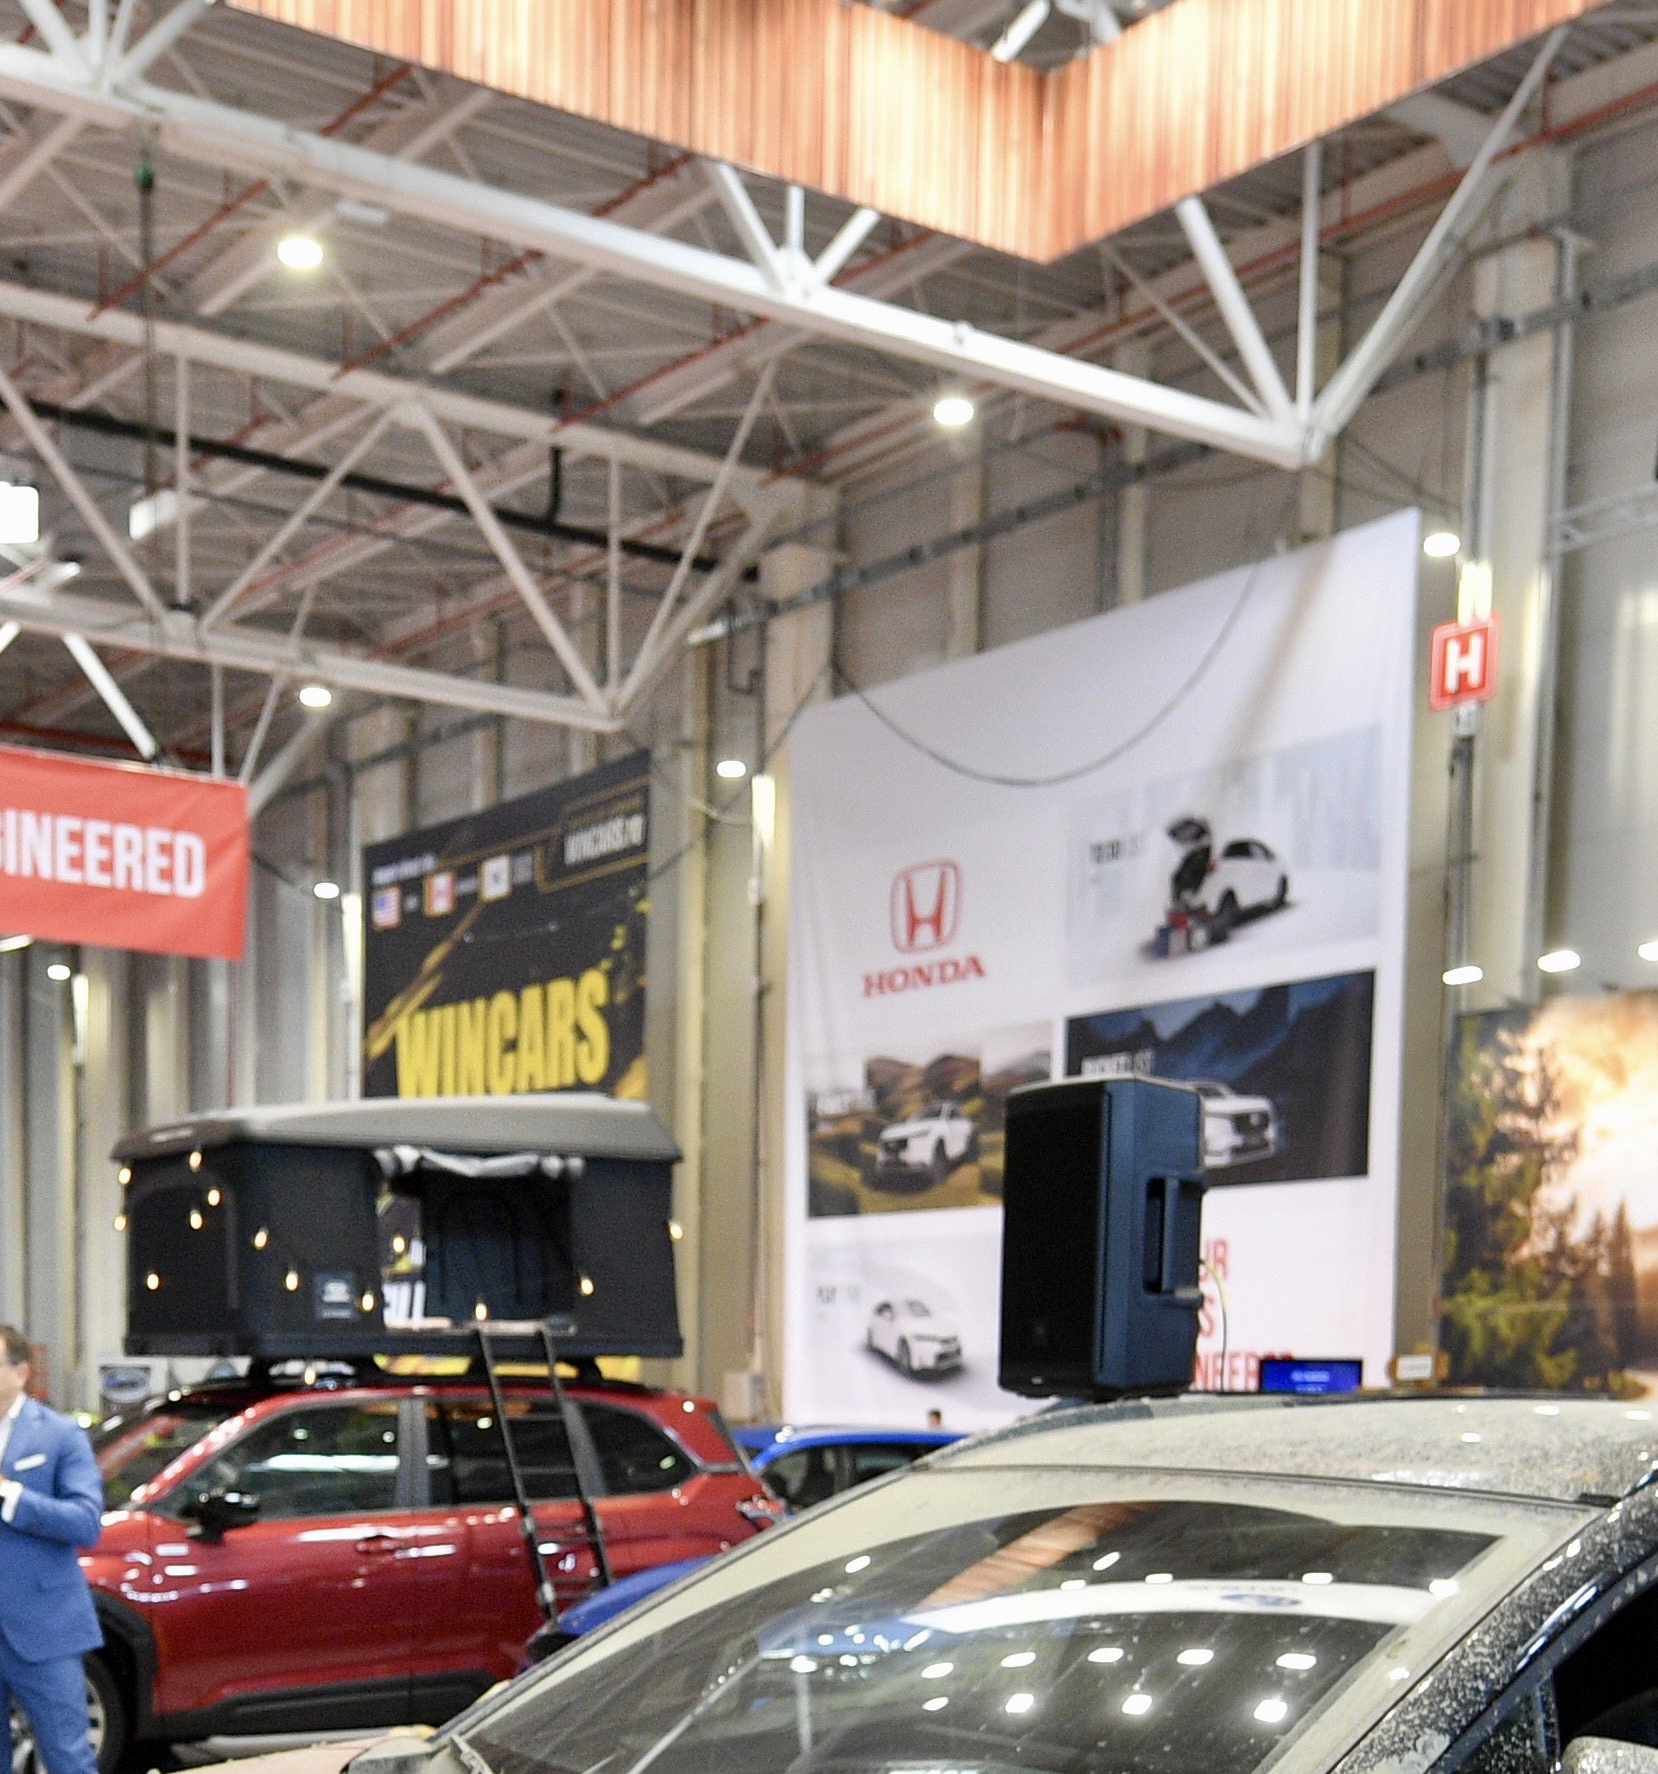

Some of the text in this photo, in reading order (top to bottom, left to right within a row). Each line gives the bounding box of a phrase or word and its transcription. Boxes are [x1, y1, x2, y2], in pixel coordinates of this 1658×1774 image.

[1444, 632, 1483, 694] H
[862, 954, 986, 998] HONDA
[394, 968, 611, 1099] WINCARS
